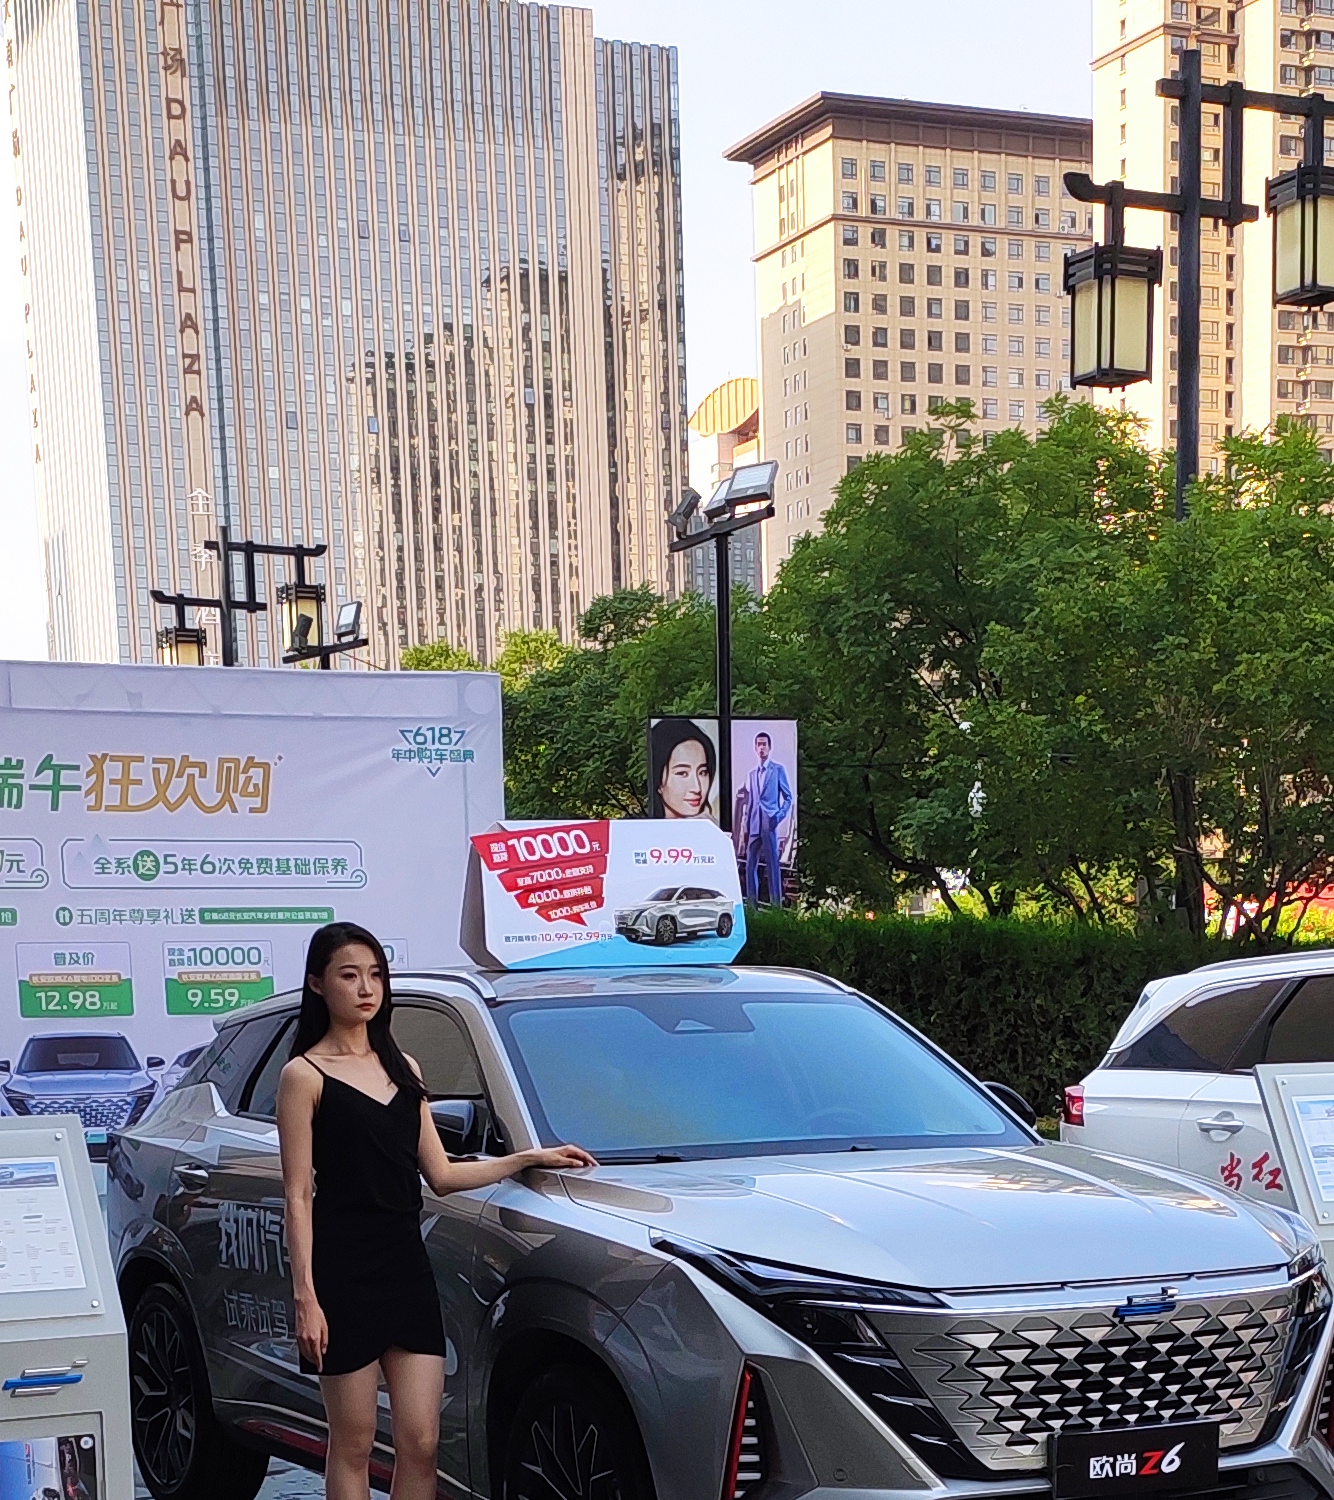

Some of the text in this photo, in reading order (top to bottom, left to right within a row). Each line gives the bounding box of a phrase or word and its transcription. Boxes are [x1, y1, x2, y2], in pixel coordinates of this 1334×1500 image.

[175, 230, 205, 418] PLAZA
[391, 746, 475, 764] 年中购车盛典
[93, 851, 349, 879] 全系送5年6次免费基础保养
[75, 907, 196, 926] 五周年尊享礼送
[54, 951, 95, 966] 普及价
[219, 1201, 289, 1278] 我的汽
[223, 1288, 289, 1339] 试乘试驾
[1089, 1441, 1186, 1479] 欧尚Z6
